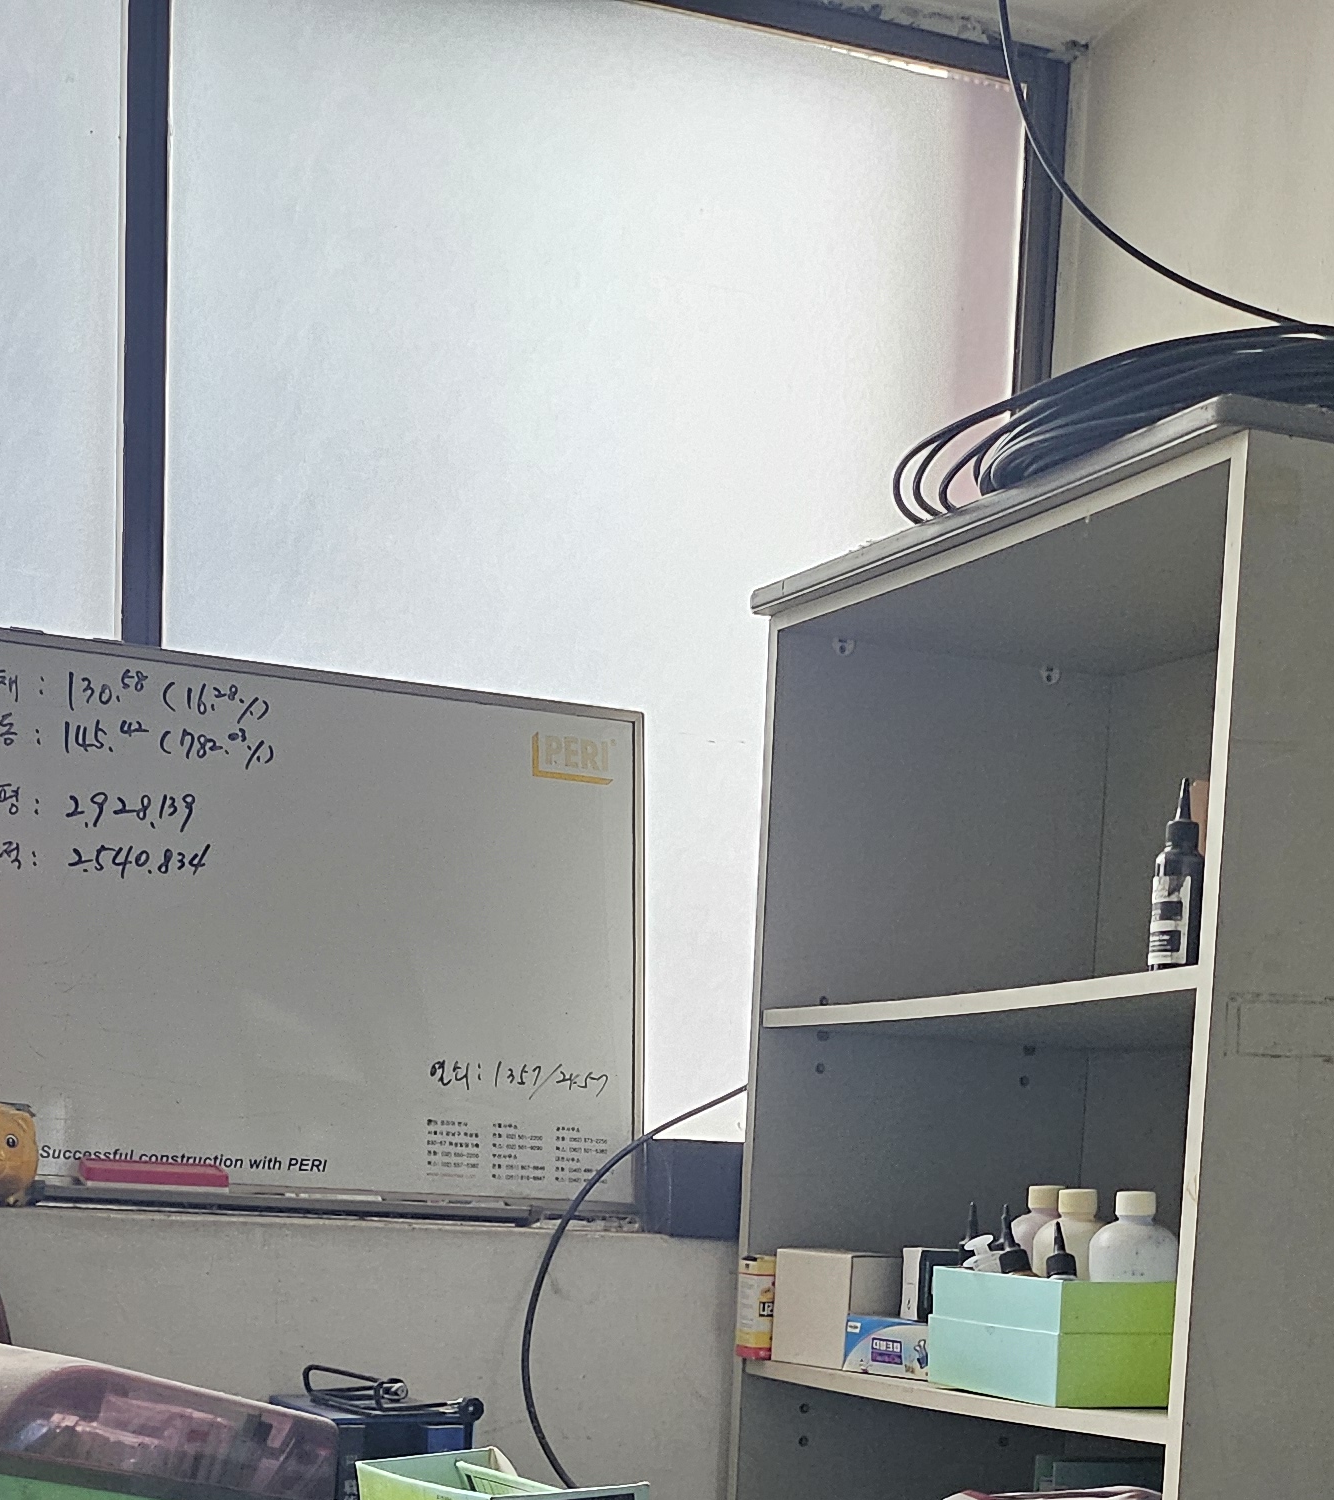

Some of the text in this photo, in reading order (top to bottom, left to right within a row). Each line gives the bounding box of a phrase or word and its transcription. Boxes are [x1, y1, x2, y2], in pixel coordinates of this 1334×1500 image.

[544, 735, 609, 773] PERI
[38, 1144, 328, 1174] Successful construction with PERI
